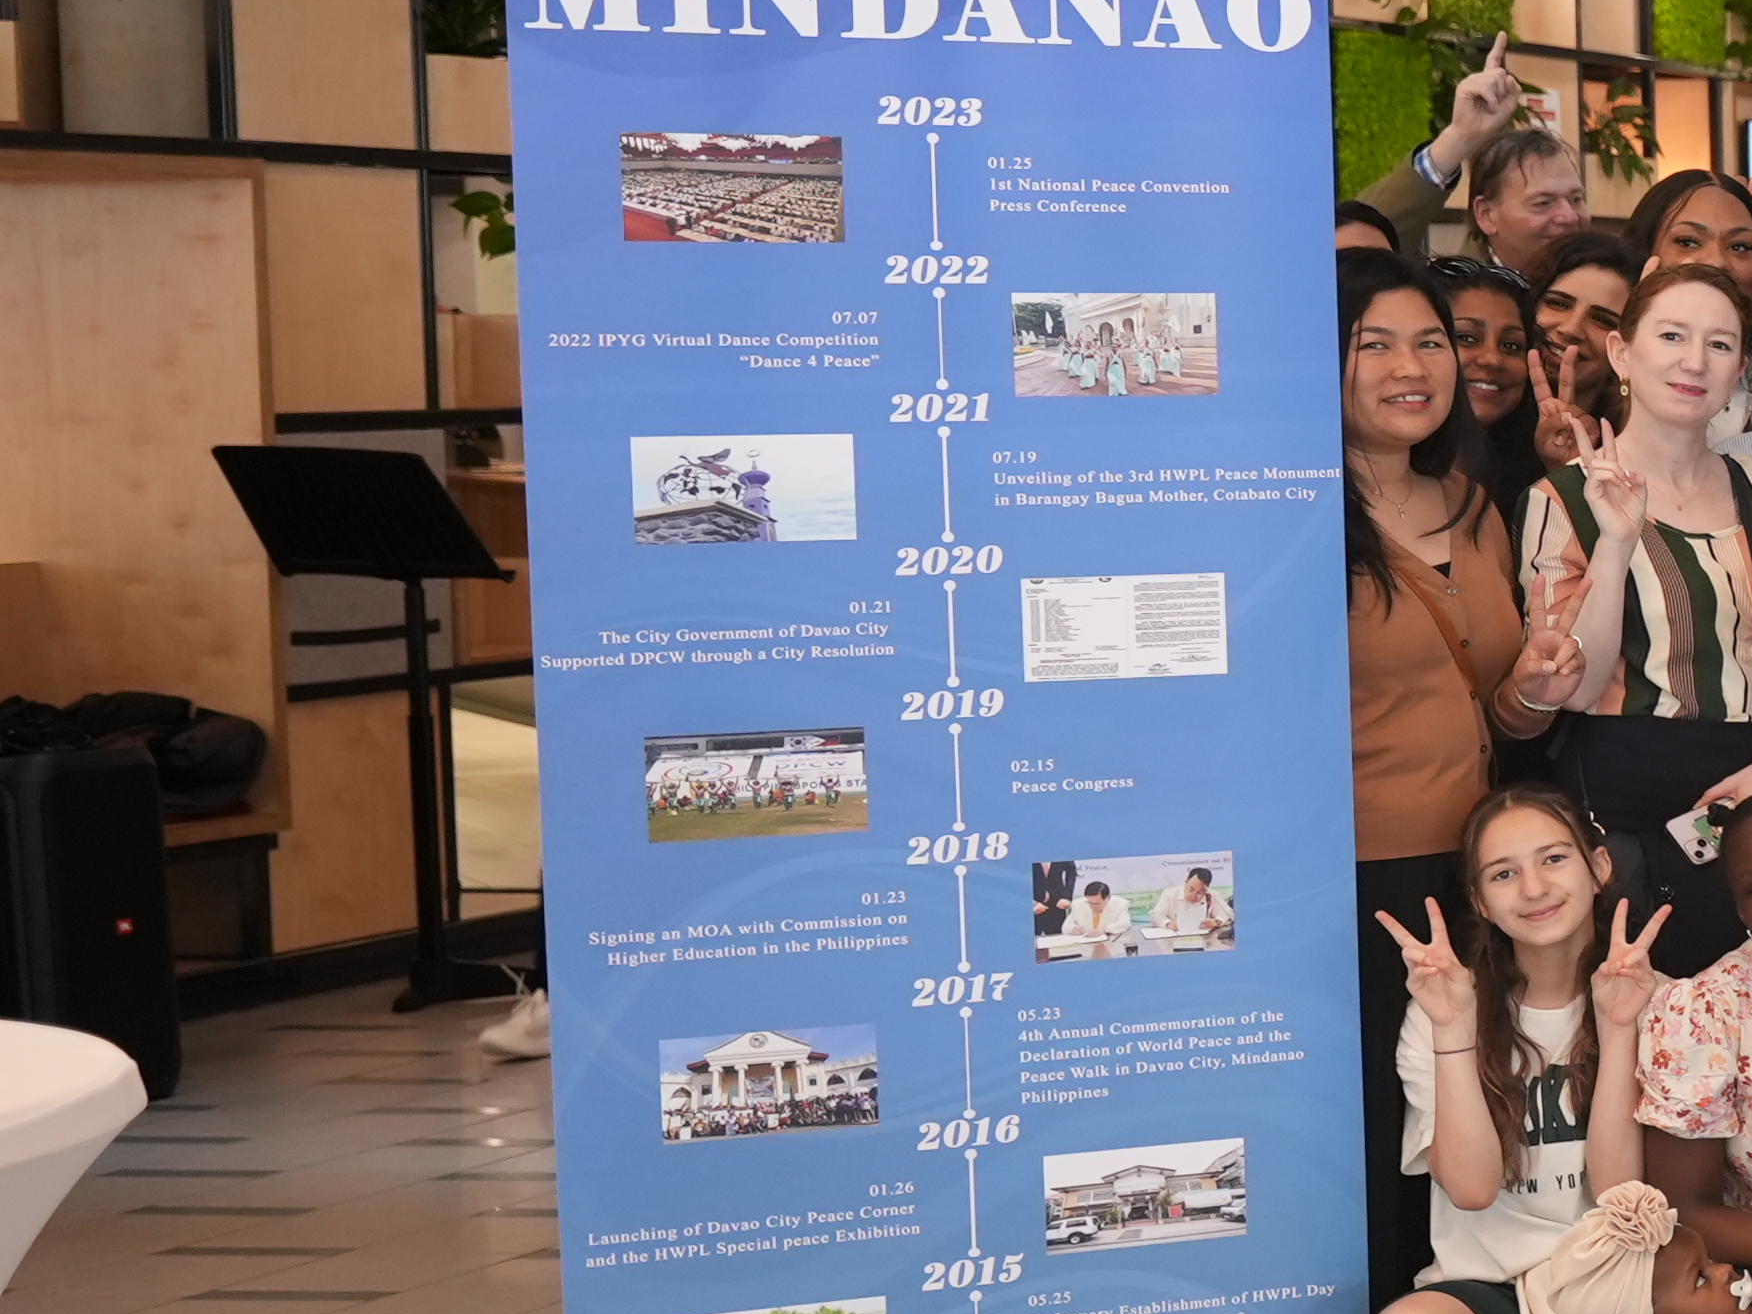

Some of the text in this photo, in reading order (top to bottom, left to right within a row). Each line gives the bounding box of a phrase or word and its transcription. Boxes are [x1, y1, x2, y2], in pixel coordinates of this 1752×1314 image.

[878, 96, 982, 126] 2023
[988, 157, 1031, 169] 01.25
[991, 178, 1229, 193] 1st National Peace Convention
[990, 200, 1126, 212] Press Conference
[885, 255, 988, 284] 2022
[832, 312, 877, 324] 07.07
[549, 333, 878, 348] 2022 IPYG Virtual Dance Competition
[808, 355, 817, 367] 4
[890, 393, 989, 422] 2021
[896, 545, 1003, 576] 2020
[901, 688, 1004, 720] 2019
[1011, 759, 1053, 772] 02.15
[1013, 779, 1133, 793] Peace Congress
[907, 832, 1009, 868] 2018
[862, 891, 905, 905] 01.23
[589, 930, 655, 946] Signing
[688, 924, 732, 938] MOA
[738, 921, 774, 934] with
[781, 915, 882, 931] Commission
[608, 934, 908, 967] Higher Education in the Philippines
[912, 972, 1013, 1008] 2017
[918, 1115, 1020, 1152] 2016
[922, 1253, 1024, 1291] 2015
